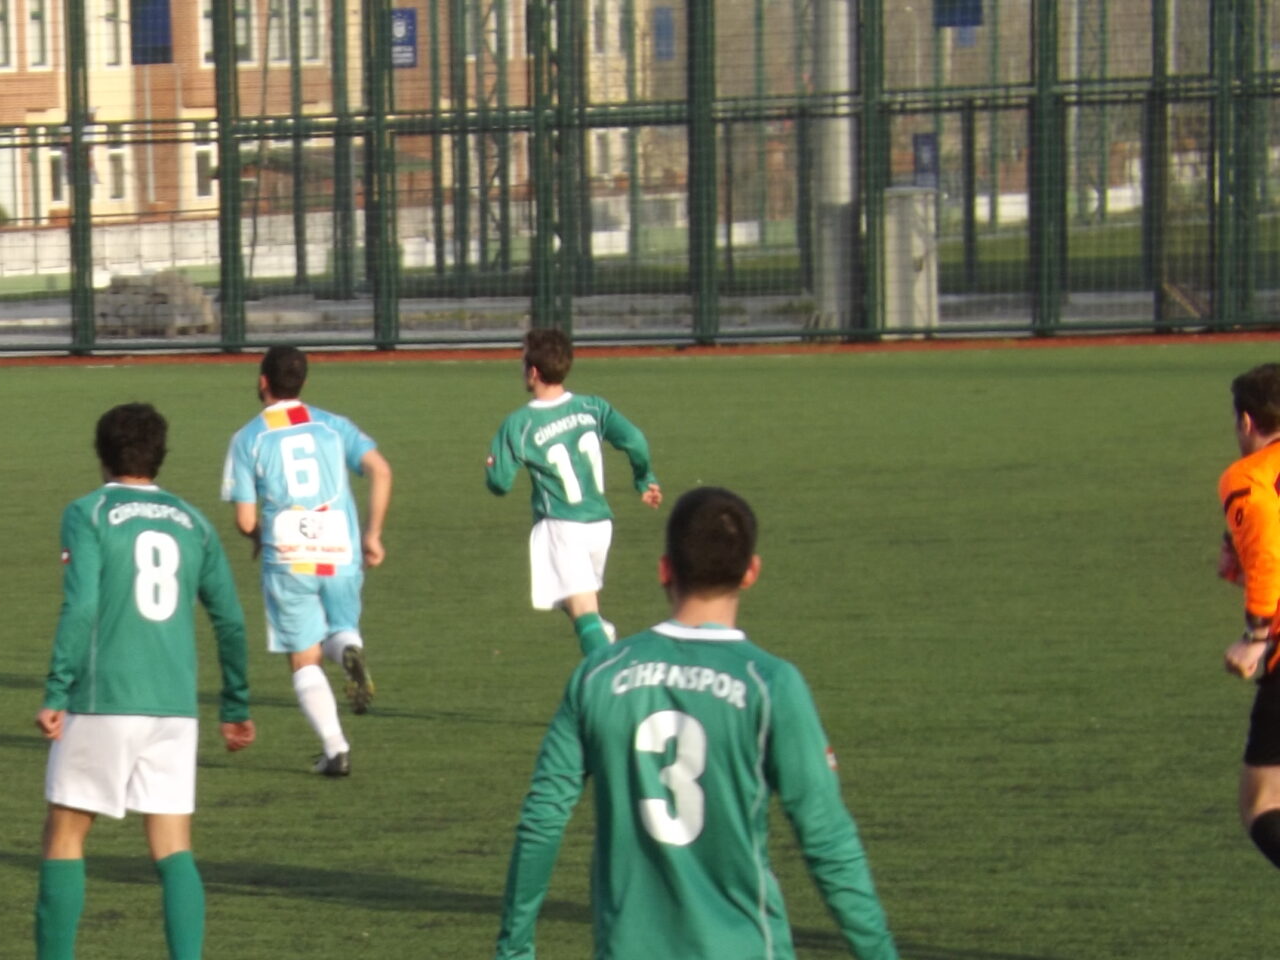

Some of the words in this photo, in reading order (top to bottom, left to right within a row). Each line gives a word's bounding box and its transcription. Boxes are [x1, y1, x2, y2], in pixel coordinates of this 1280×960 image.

[281, 433, 320, 497] 6
[547, 431, 604, 504] 11
[135, 530, 180, 621] 8
[635, 710, 707, 846] 3
